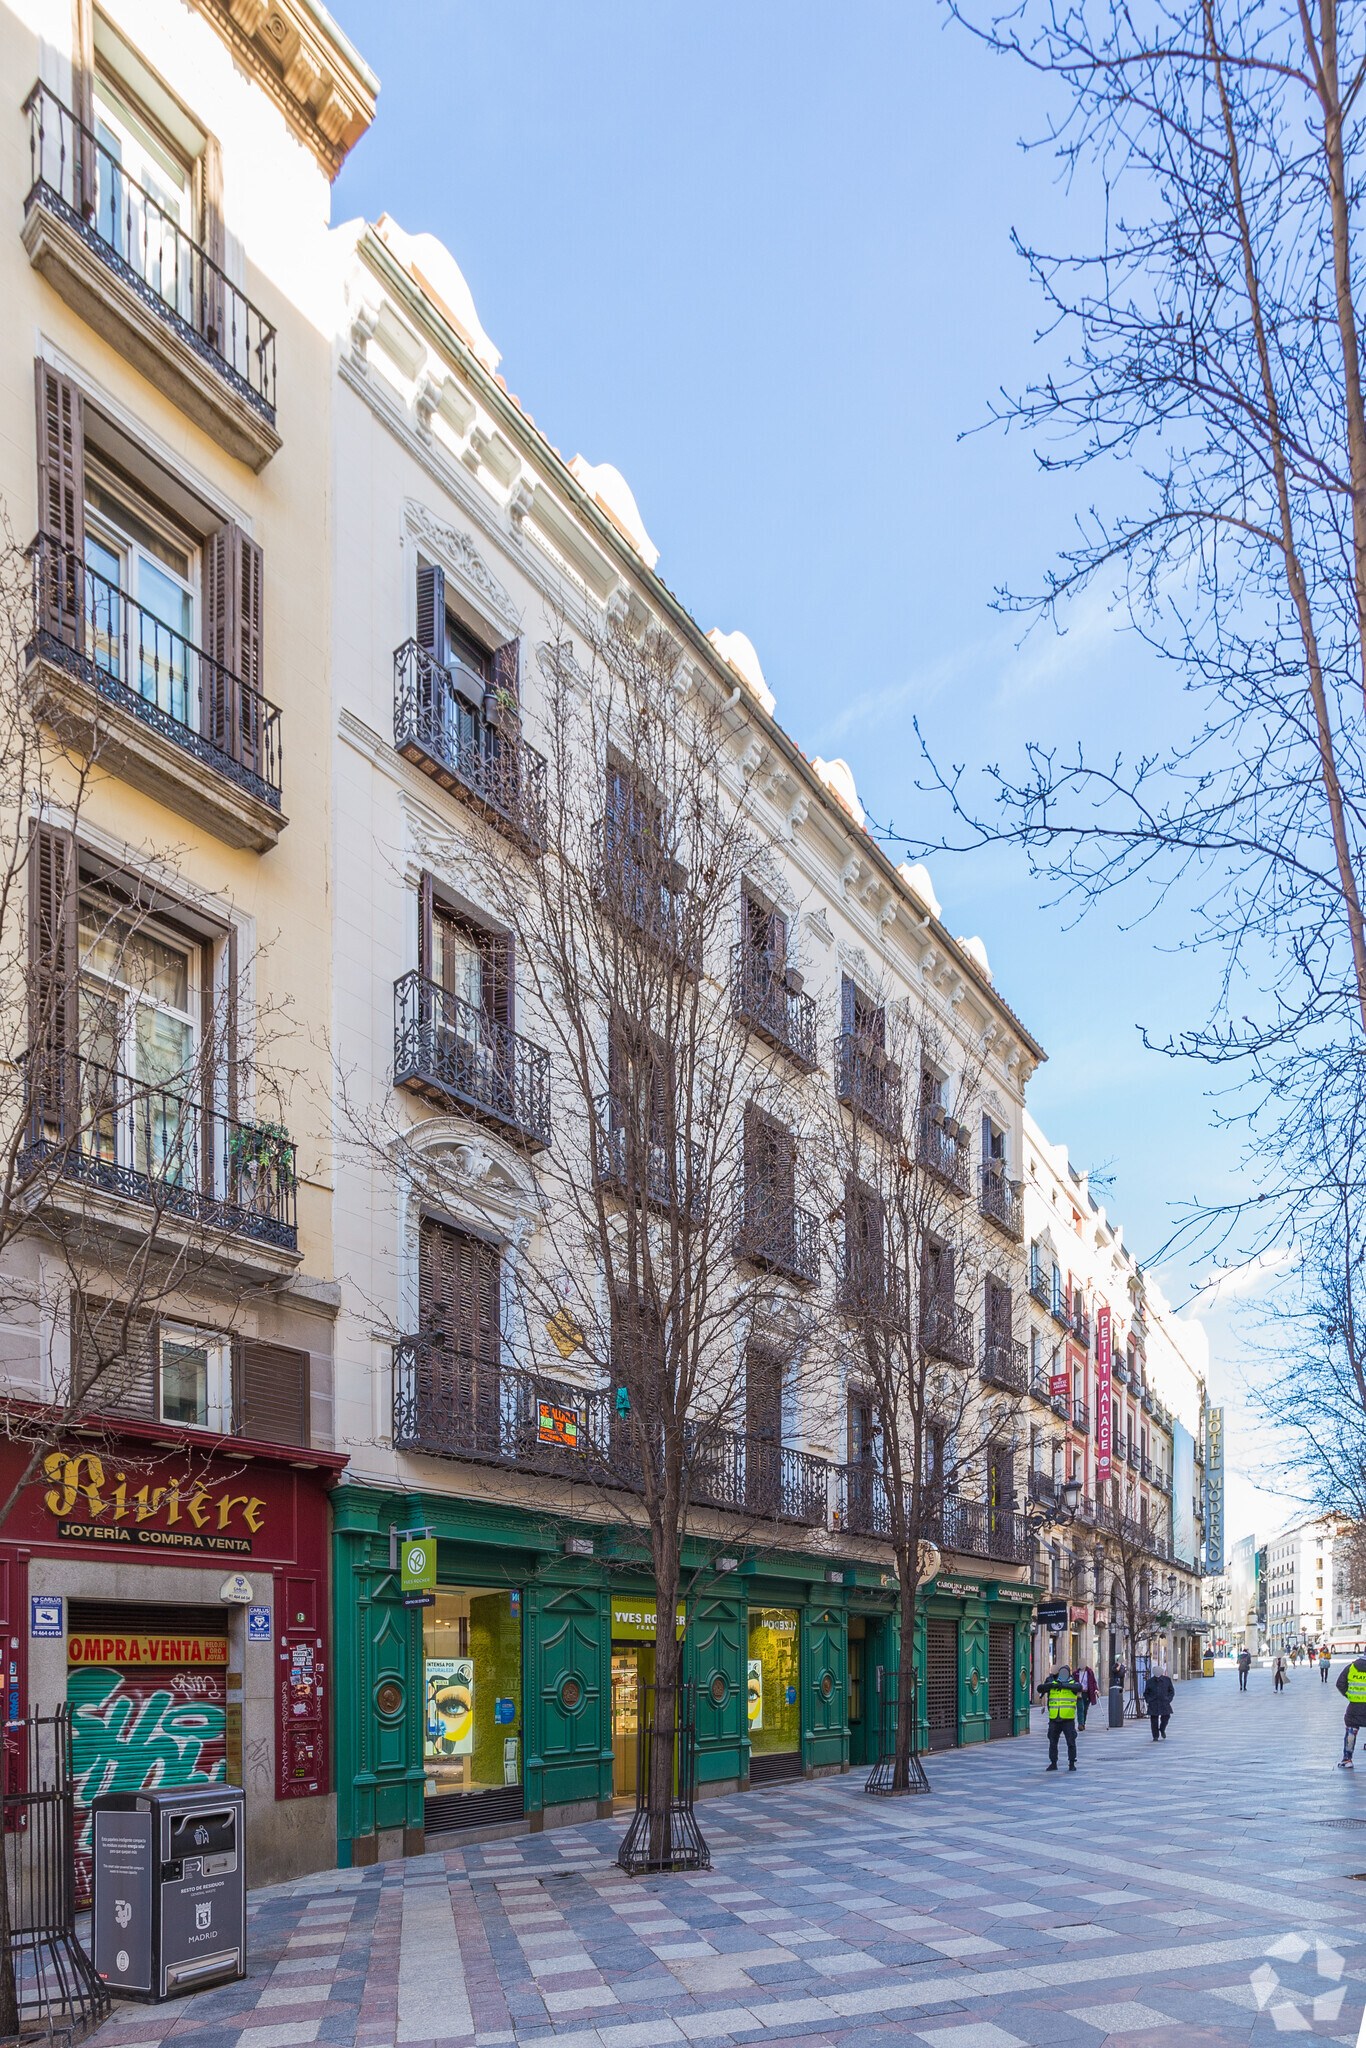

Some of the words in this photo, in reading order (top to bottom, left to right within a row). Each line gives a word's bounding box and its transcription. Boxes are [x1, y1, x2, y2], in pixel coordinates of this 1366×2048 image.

[1101, 1315, 1109, 1374] PETIT
[1101, 1380, 1109, 1450] PALACE
[1208, 1408, 1221, 1470] HOTEL
[43, 1452, 266, 1533] Rivière
[1207, 1477, 1223, 1562] MODERNO
[61, 1525, 131, 1541] JOYERÍA
[138, 1531, 204, 1547] COMPRA
[207, 1537, 251, 1551] VENTA
[936, 1580, 963, 1590] CAROLINA
[963, 1584, 979, 1593] LEMKE
[998, 1589, 1020, 1597] CAROLINA
[614, 1612, 642, 1624] YVES
[644, 1613, 686, 1626] ROER
[148, 1639, 202, 1661] VENTA
[209, 1647, 222, 1655] ORO
[180, 1886, 196, 1894] RESTO
[203, 1881, 225, 1890] RESIDUOS
[188, 1930, 218, 1944] MADRID
